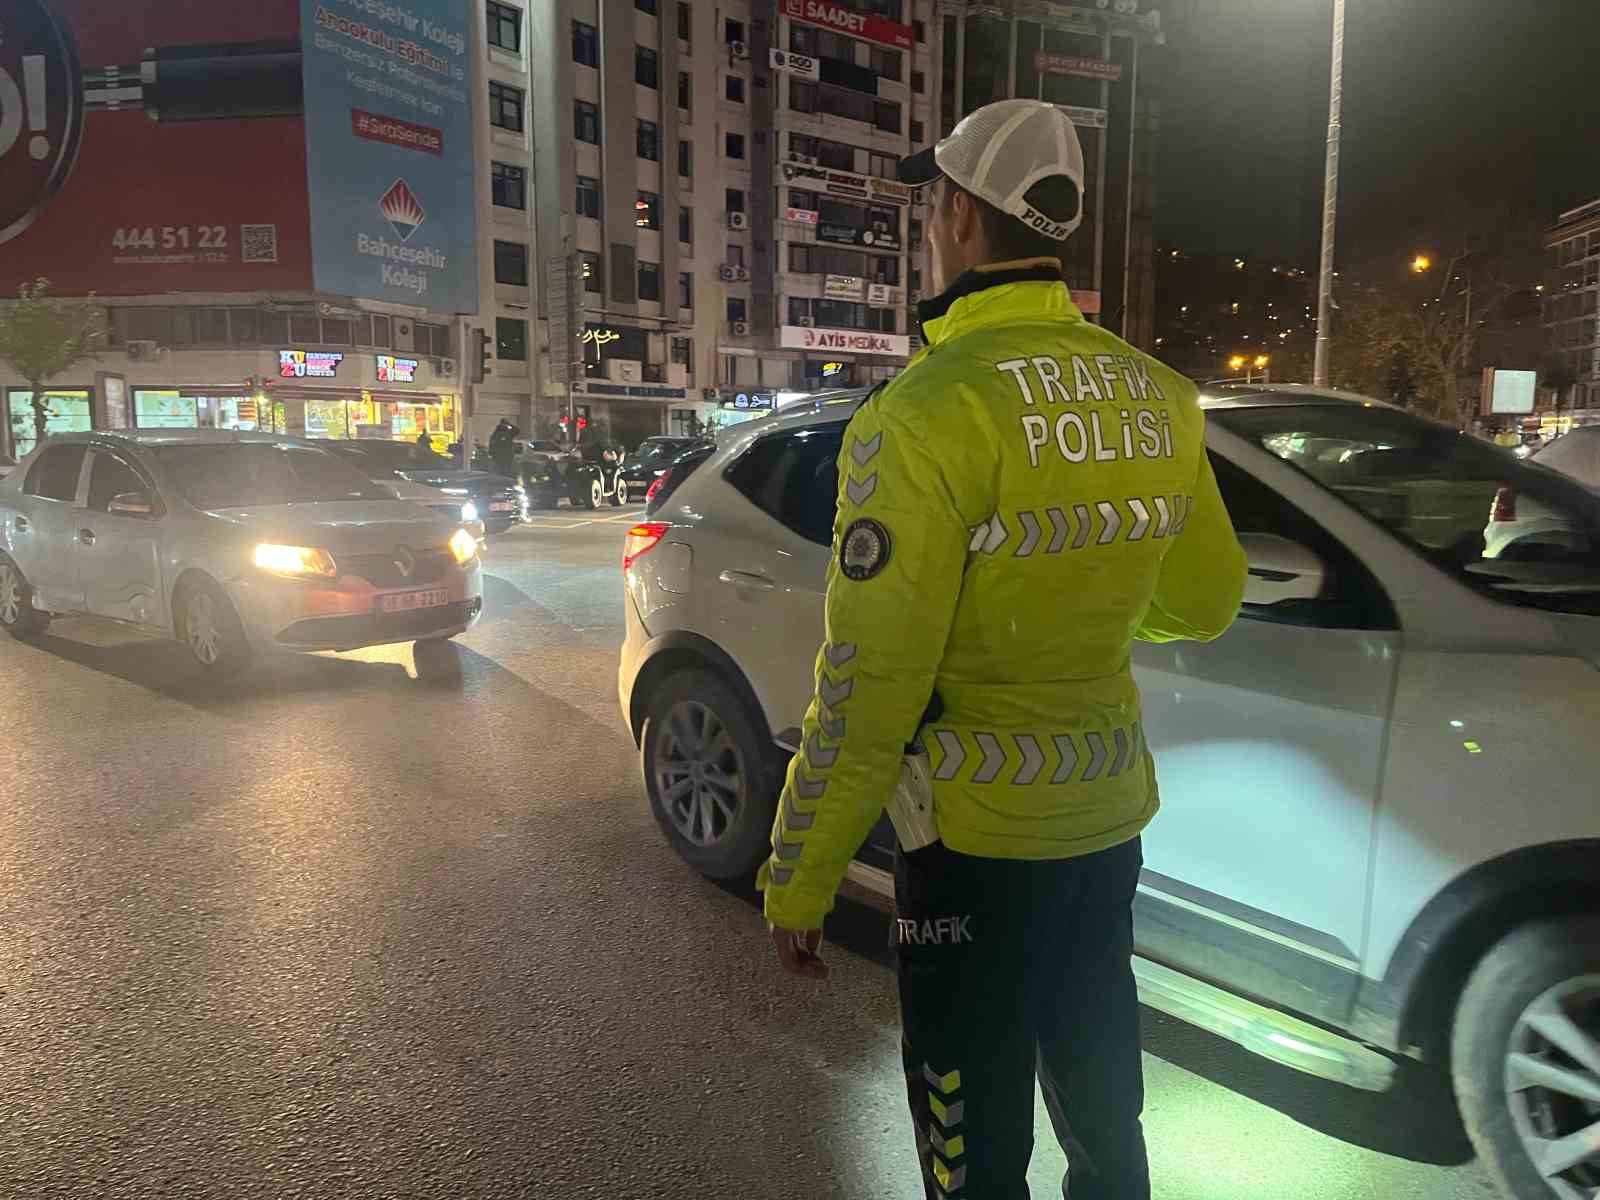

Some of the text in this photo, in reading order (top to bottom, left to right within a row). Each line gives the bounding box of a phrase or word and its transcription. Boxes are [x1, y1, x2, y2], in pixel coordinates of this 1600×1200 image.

[807, 1, 867, 32] SAADET
[422, 18, 466, 56] Koleji
[112, 225, 228, 250] 444 51 22
[382, 262, 428, 296] Koleji
[848, 336, 893, 352] MEDİKAL
